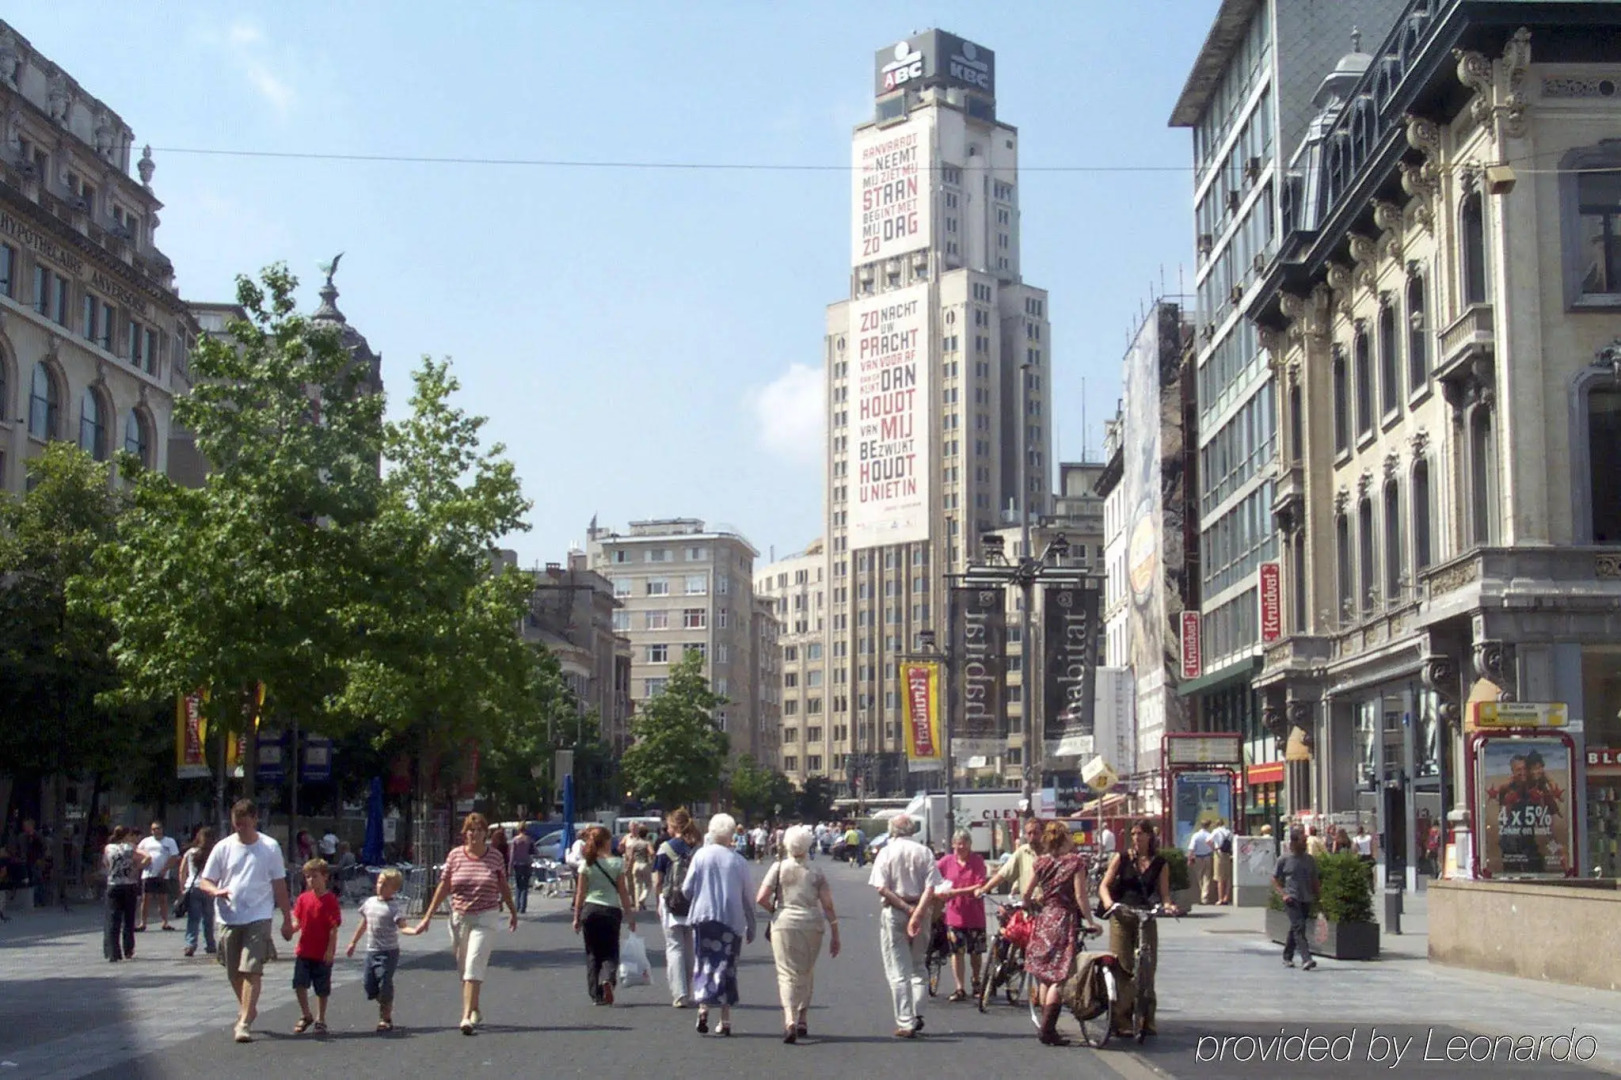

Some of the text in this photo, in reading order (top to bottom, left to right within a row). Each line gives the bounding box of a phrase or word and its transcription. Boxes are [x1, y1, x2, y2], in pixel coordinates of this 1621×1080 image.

[950, 61, 989, 90] KBC
[875, 145, 918, 171] NEEMT
[863, 173, 878, 189] MIJ
[881, 168, 899, 184] ZIET
[863, 174, 918, 211] STAAN
[863, 198, 918, 224] BEGINT MET
[863, 212, 918, 242] MIJ DAG
[863, 236, 880, 257] ZO
[861, 300, 918, 332] ZO NACHT
[881, 322, 894, 335] UW
[861, 328, 918, 359] PRACHT
[861, 359, 878, 372] VAN
[881, 363, 916, 392] DAN
[860, 388, 916, 420] HOUDT
[861, 412, 912, 442] VAN MIJ
[860, 454, 916, 485] HOUDT
[860, 478, 916, 503] U NIET IN
[1264, 573, 1279, 632] Kruidvat
[1185, 620, 1197, 669] Kruidvat
[1057, 609, 1087, 722] habitat
[1498, 805, 1552, 826] 4 x 5%
